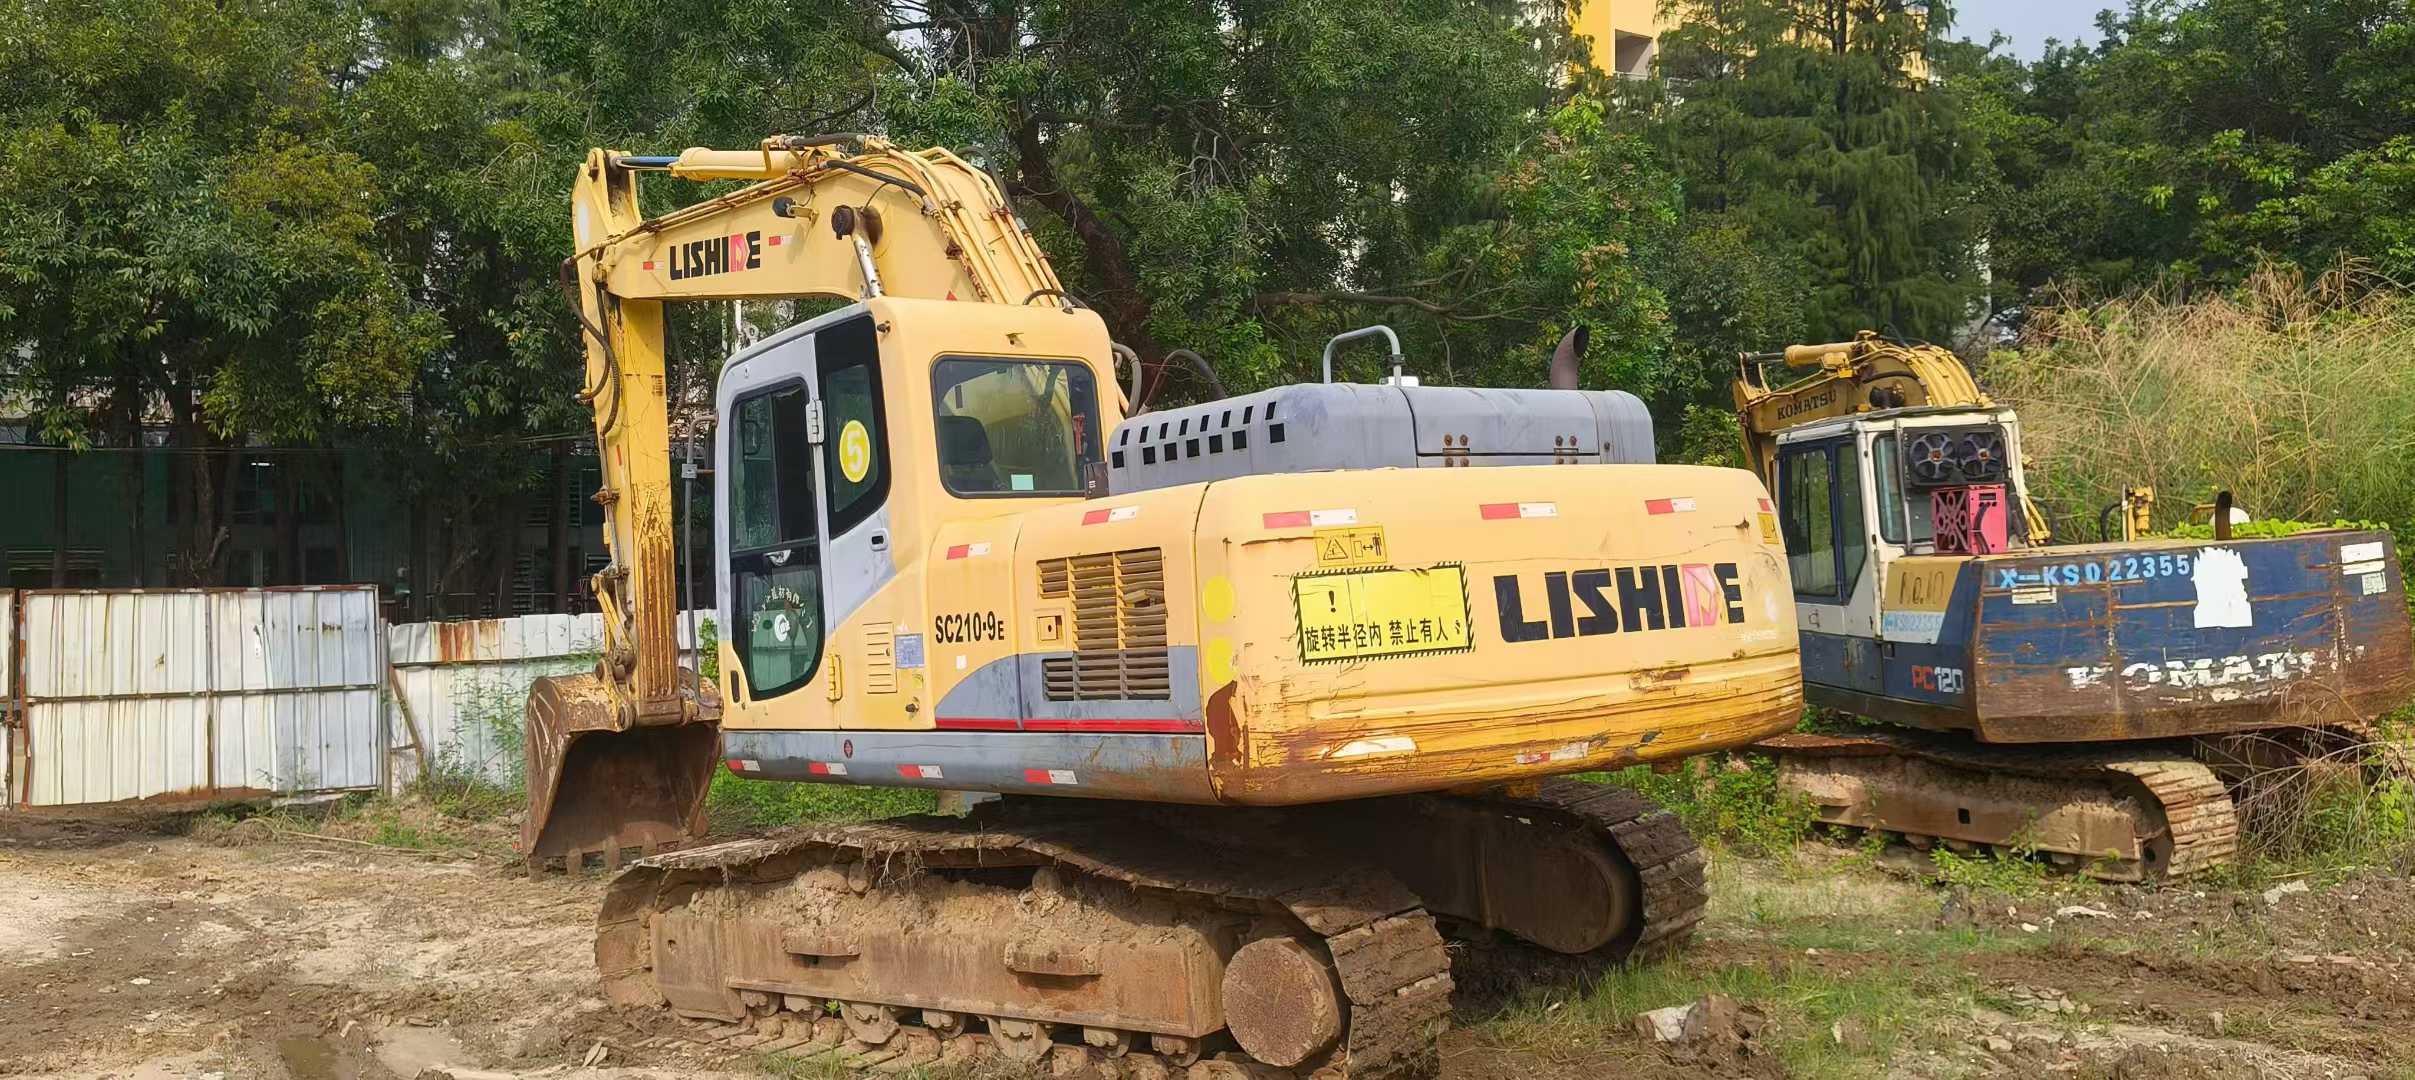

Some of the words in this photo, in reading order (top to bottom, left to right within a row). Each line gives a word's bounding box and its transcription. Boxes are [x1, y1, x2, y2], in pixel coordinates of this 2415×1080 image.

[669, 230, 761, 281] LISHIDE
[1777, 390, 1837, 420] KOMATSU
[847, 431, 864, 472] 5
[1493, 563, 1745, 643] LISHIDE
[1304, 621, 1382, 652] 旋转半径内
[1388, 616, 1449, 645] 禁止有人
[1911, 664, 1964, 693] PC120
